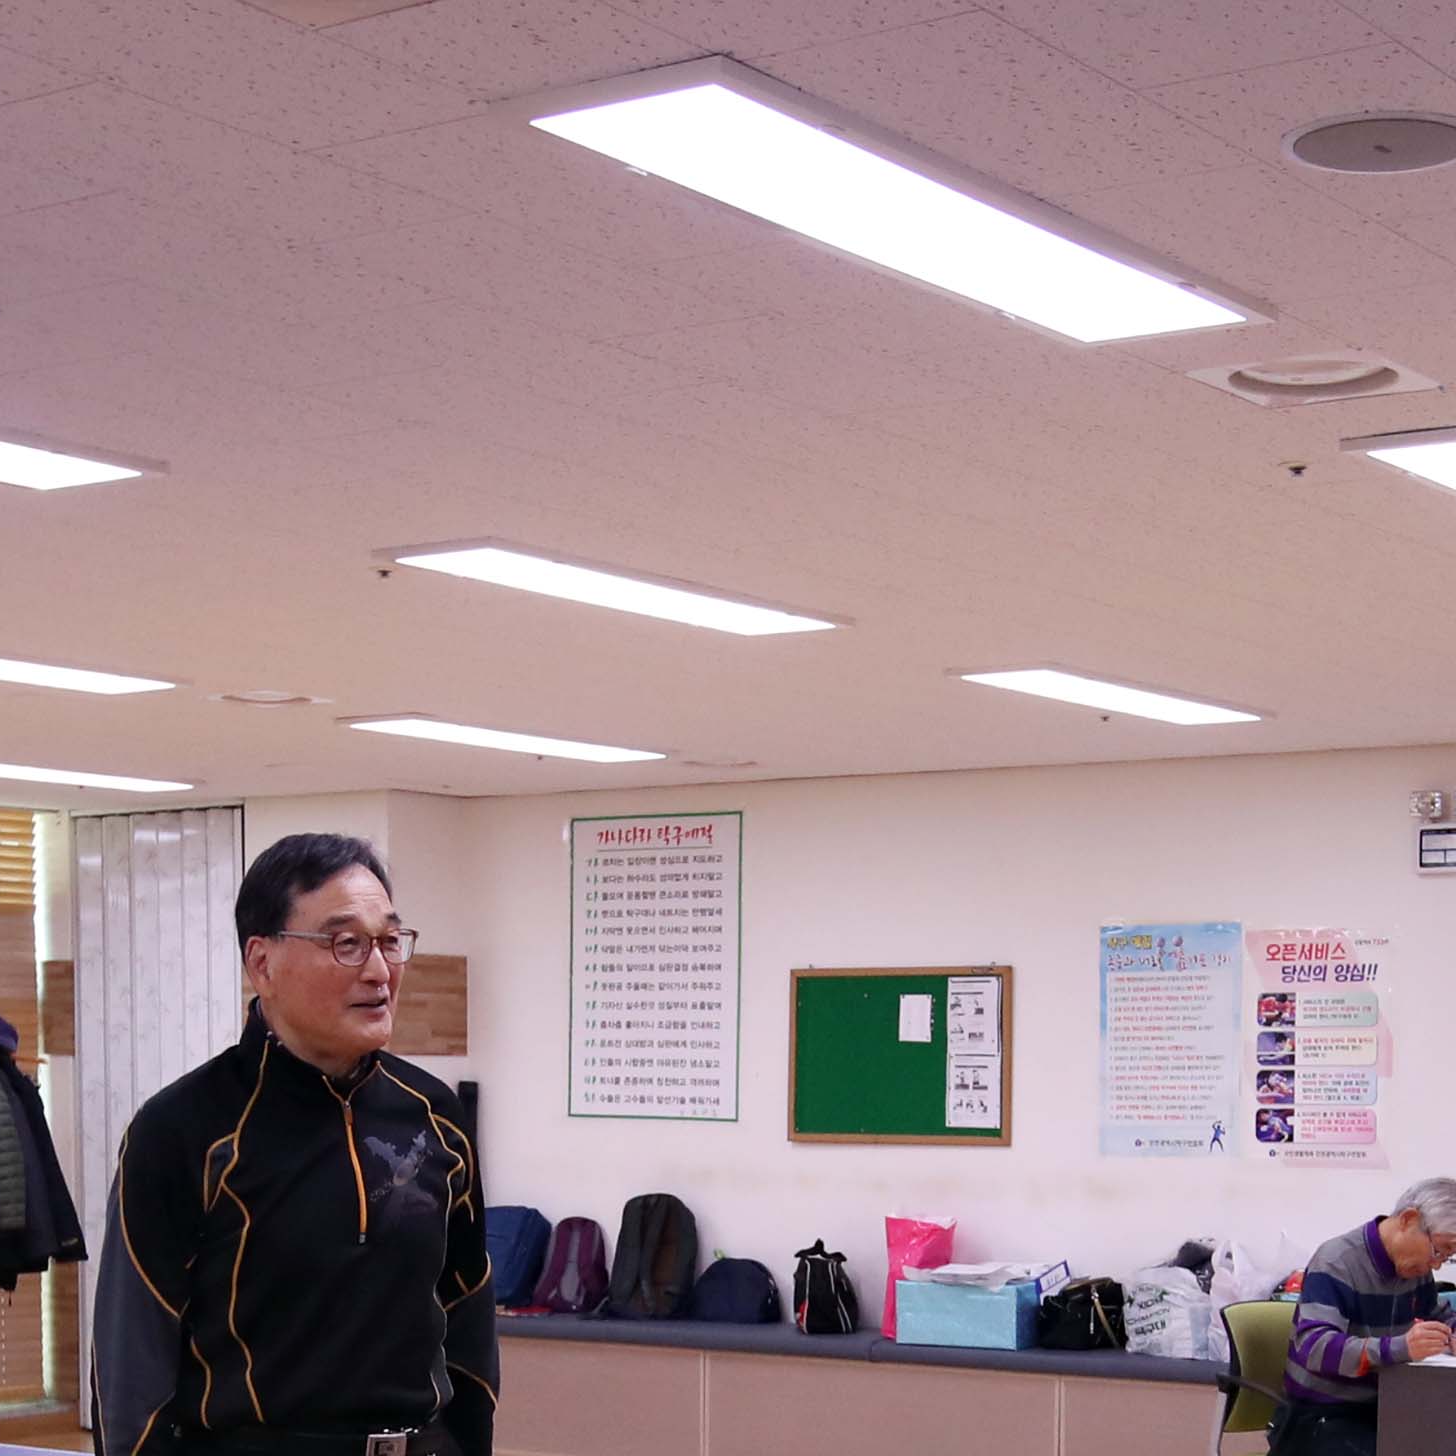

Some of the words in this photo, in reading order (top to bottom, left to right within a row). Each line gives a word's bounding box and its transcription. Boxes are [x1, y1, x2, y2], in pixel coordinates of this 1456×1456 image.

[597, 826, 651, 845] 가나다라
[657, 824, 713, 846] 탁구예절
[1265, 942, 1346, 961] 오픈서비스
[1281, 964, 1327, 983] 당신의
[1334, 963, 1379, 982] 양심!!
